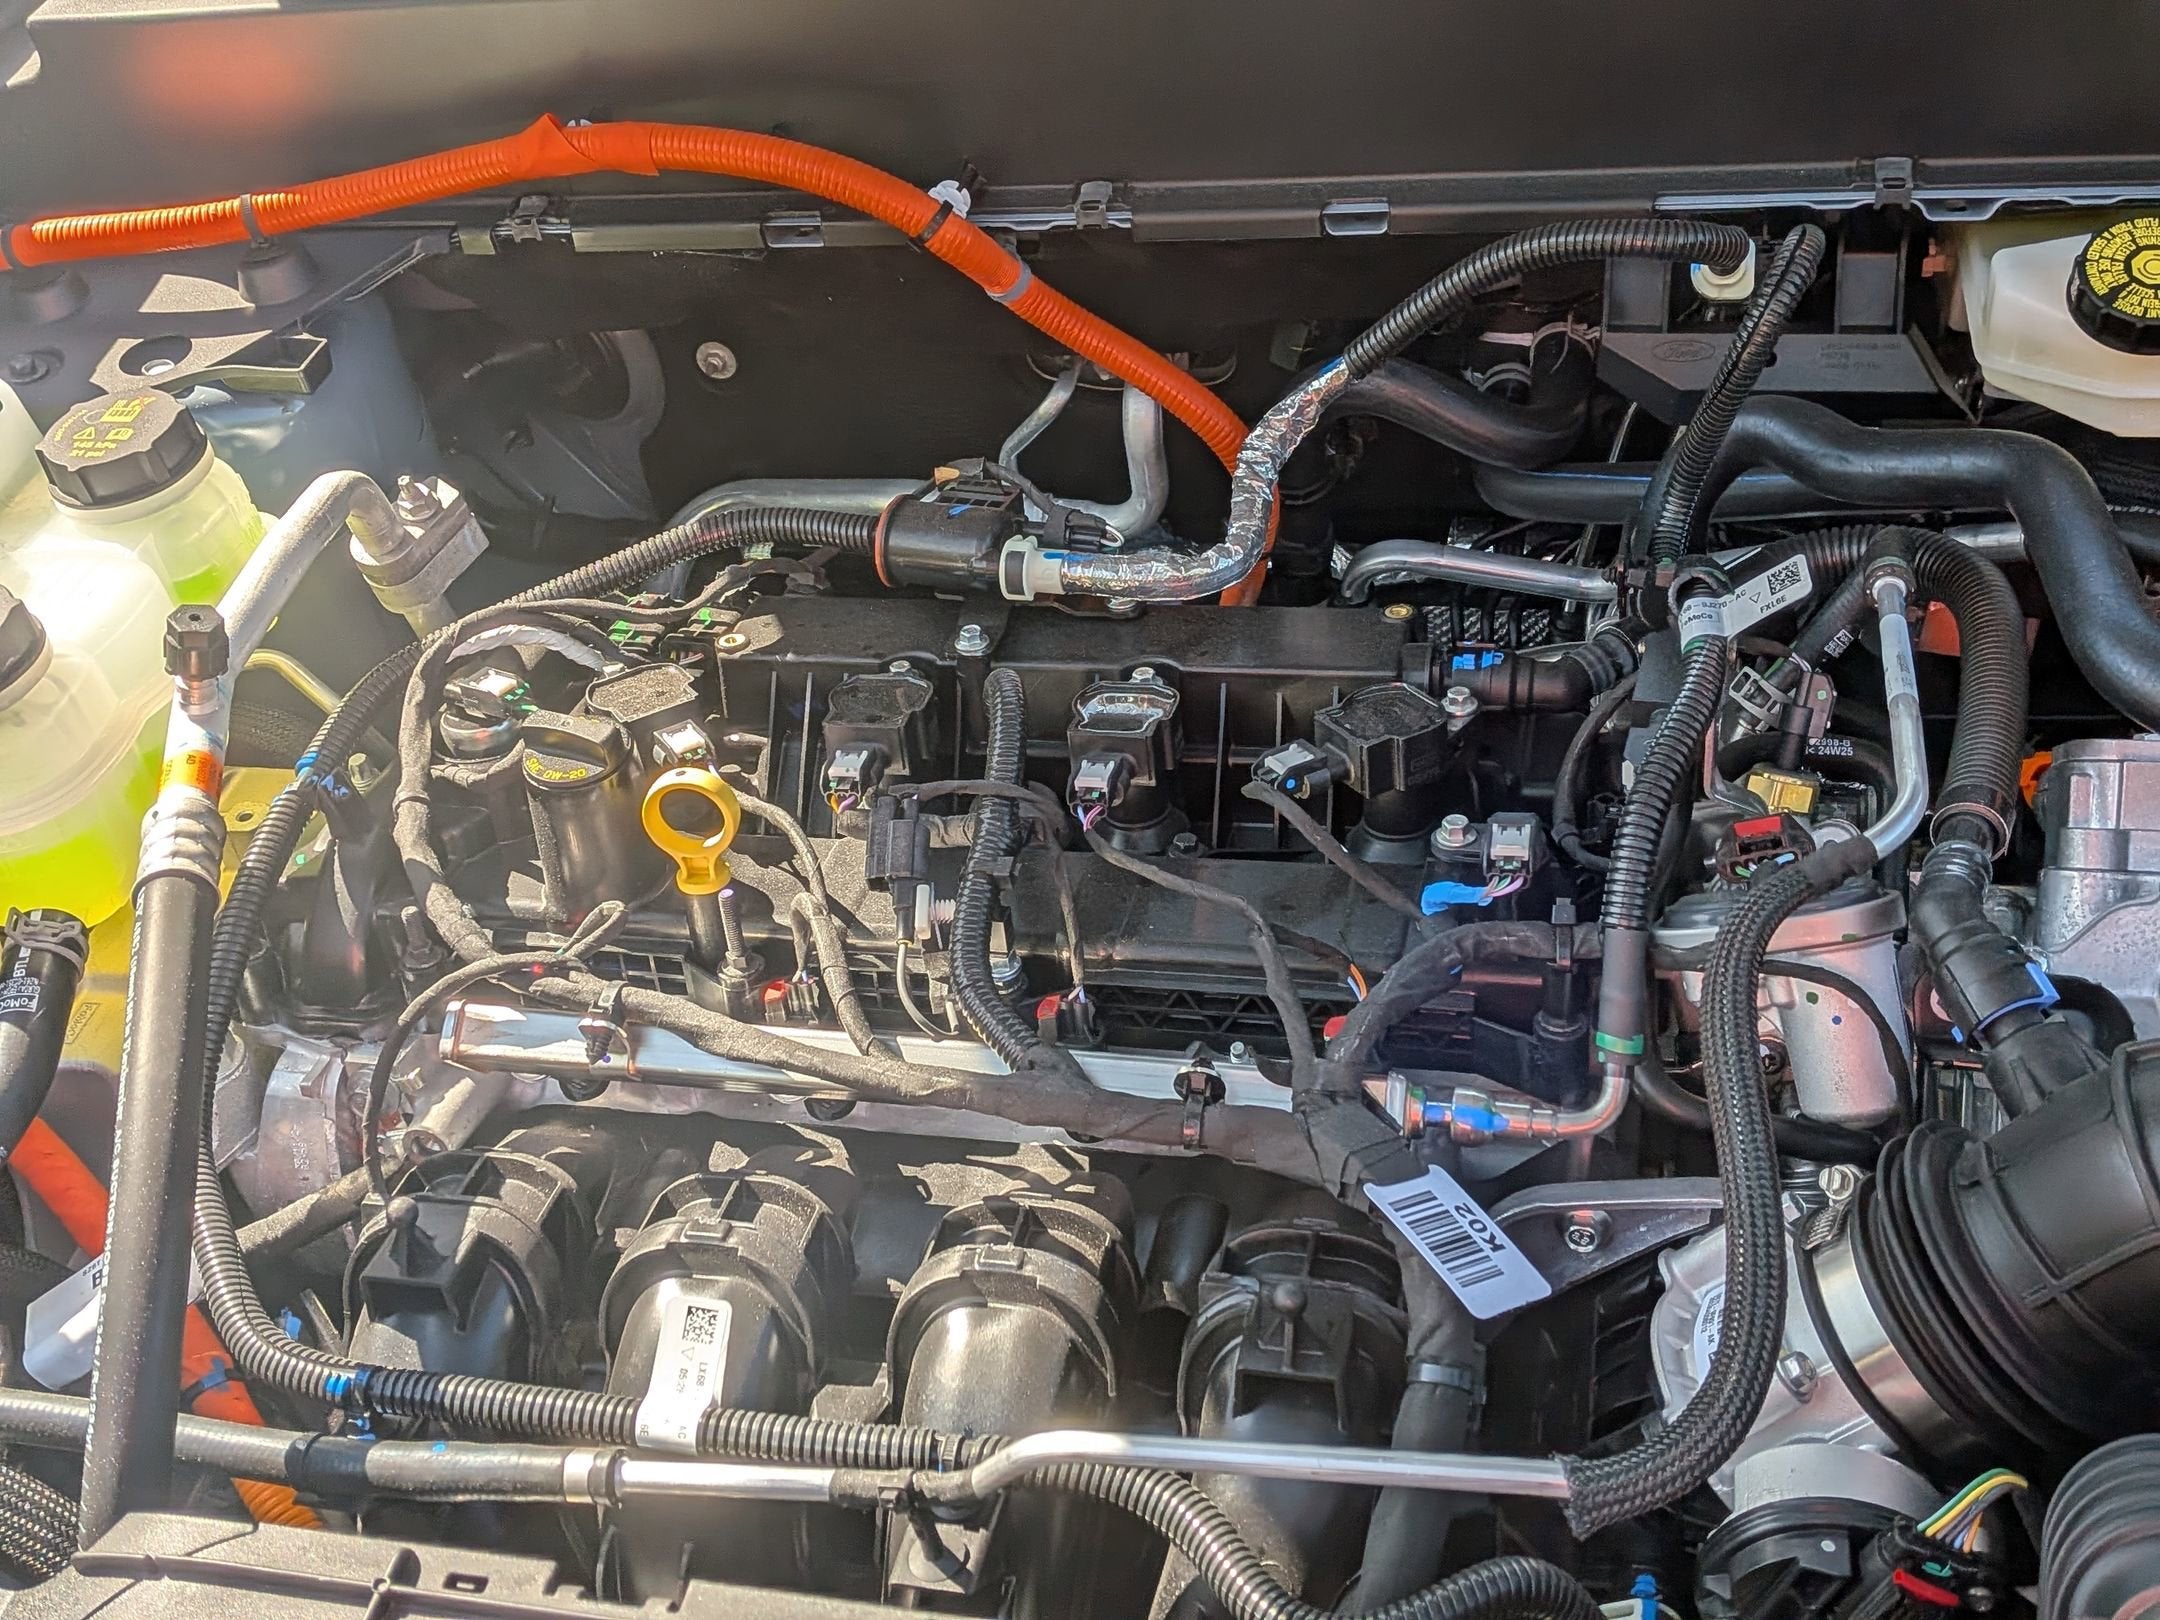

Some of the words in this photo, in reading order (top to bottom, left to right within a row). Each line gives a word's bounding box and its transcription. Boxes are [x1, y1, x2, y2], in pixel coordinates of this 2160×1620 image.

[2109, 220, 2133, 234] FROM
[2134, 217, 2159, 227] FLUID
[2101, 231, 2113, 240] A
[2137, 236, 2160, 246] RNING
[2086, 237, 2108, 260] SEALED
[2113, 241, 2137, 260] CLEAN
[2098, 259, 2111, 271] USE
[2111, 261, 2130, 285] FILLER
[2085, 261, 2110, 296] CONTAINER
[2101, 272, 2119, 289] ONLY
[2123, 293, 2140, 305] DOT
[2141, 298, 2160, 308] REIN
[1760, 594, 1787, 614] FXL6E
[1818, 746, 1854, 756] 24W25
[526, 758, 544, 774] SAE
[543, 768, 586, 780] 0W-20
[13, 957, 29, 977] BTL
[106, 1157, 120, 1235] SUCTION
[1454, 1202, 1507, 1254] K02
[101, 1237, 113, 1288] HOSE
